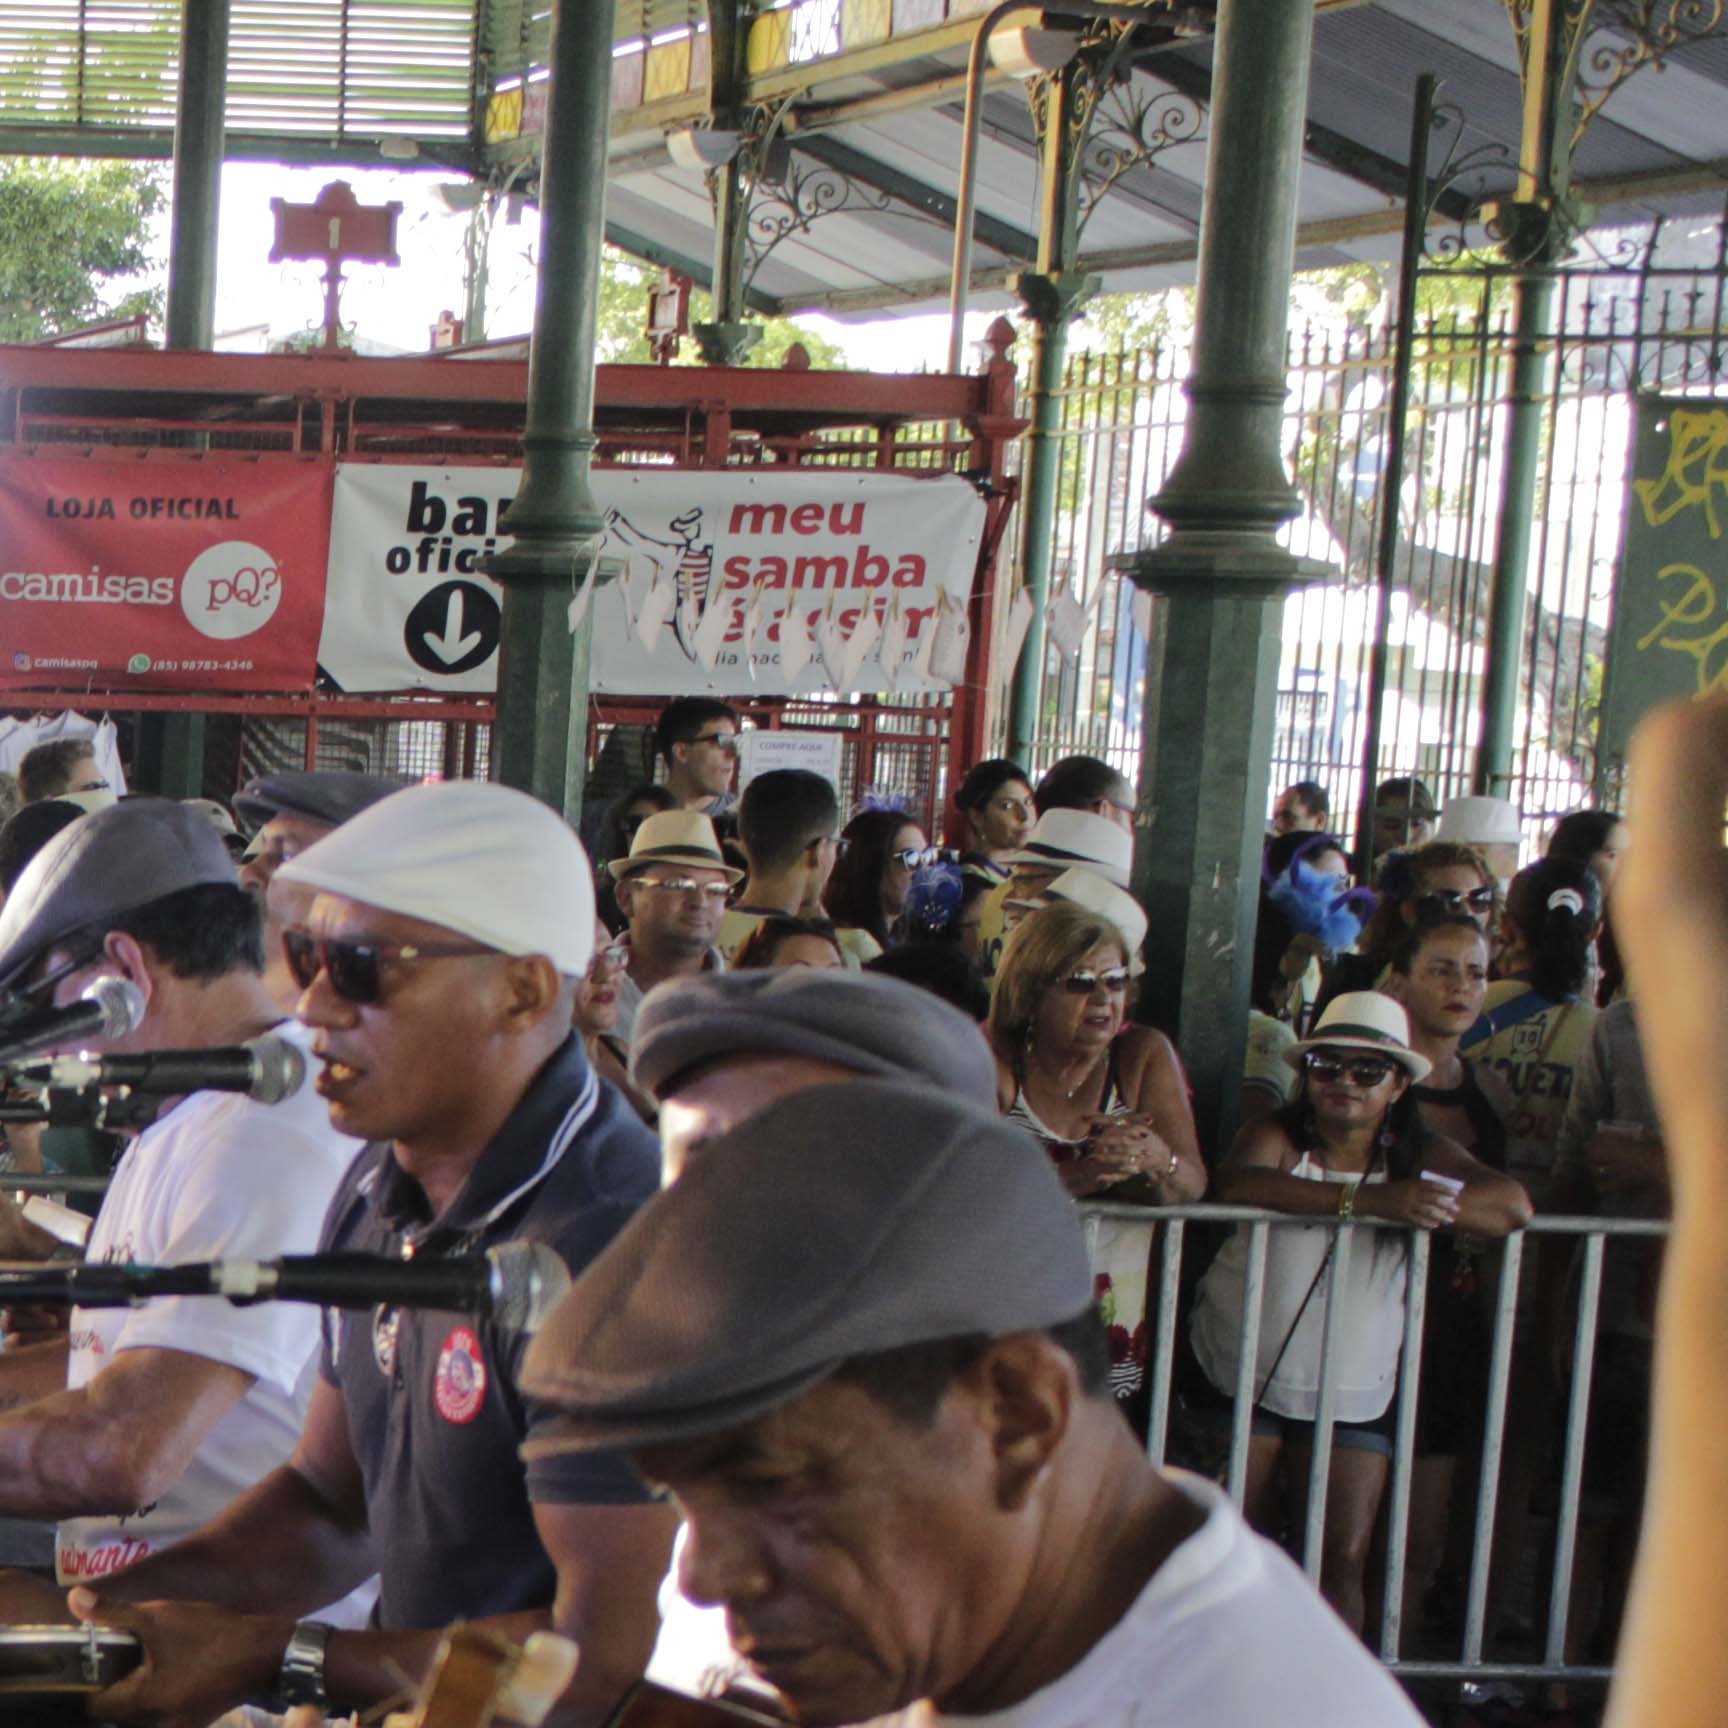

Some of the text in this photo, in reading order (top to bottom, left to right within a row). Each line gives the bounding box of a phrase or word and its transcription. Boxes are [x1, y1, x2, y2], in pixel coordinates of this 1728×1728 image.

[327, 217, 340, 249] 1
[47, 497, 240, 520] LOJA OFICIAL
[728, 502, 867, 535] meu
[385, 536, 498, 574] ofici
[723, 545, 928, 590] samba
[0, 565, 174, 605] camisas
